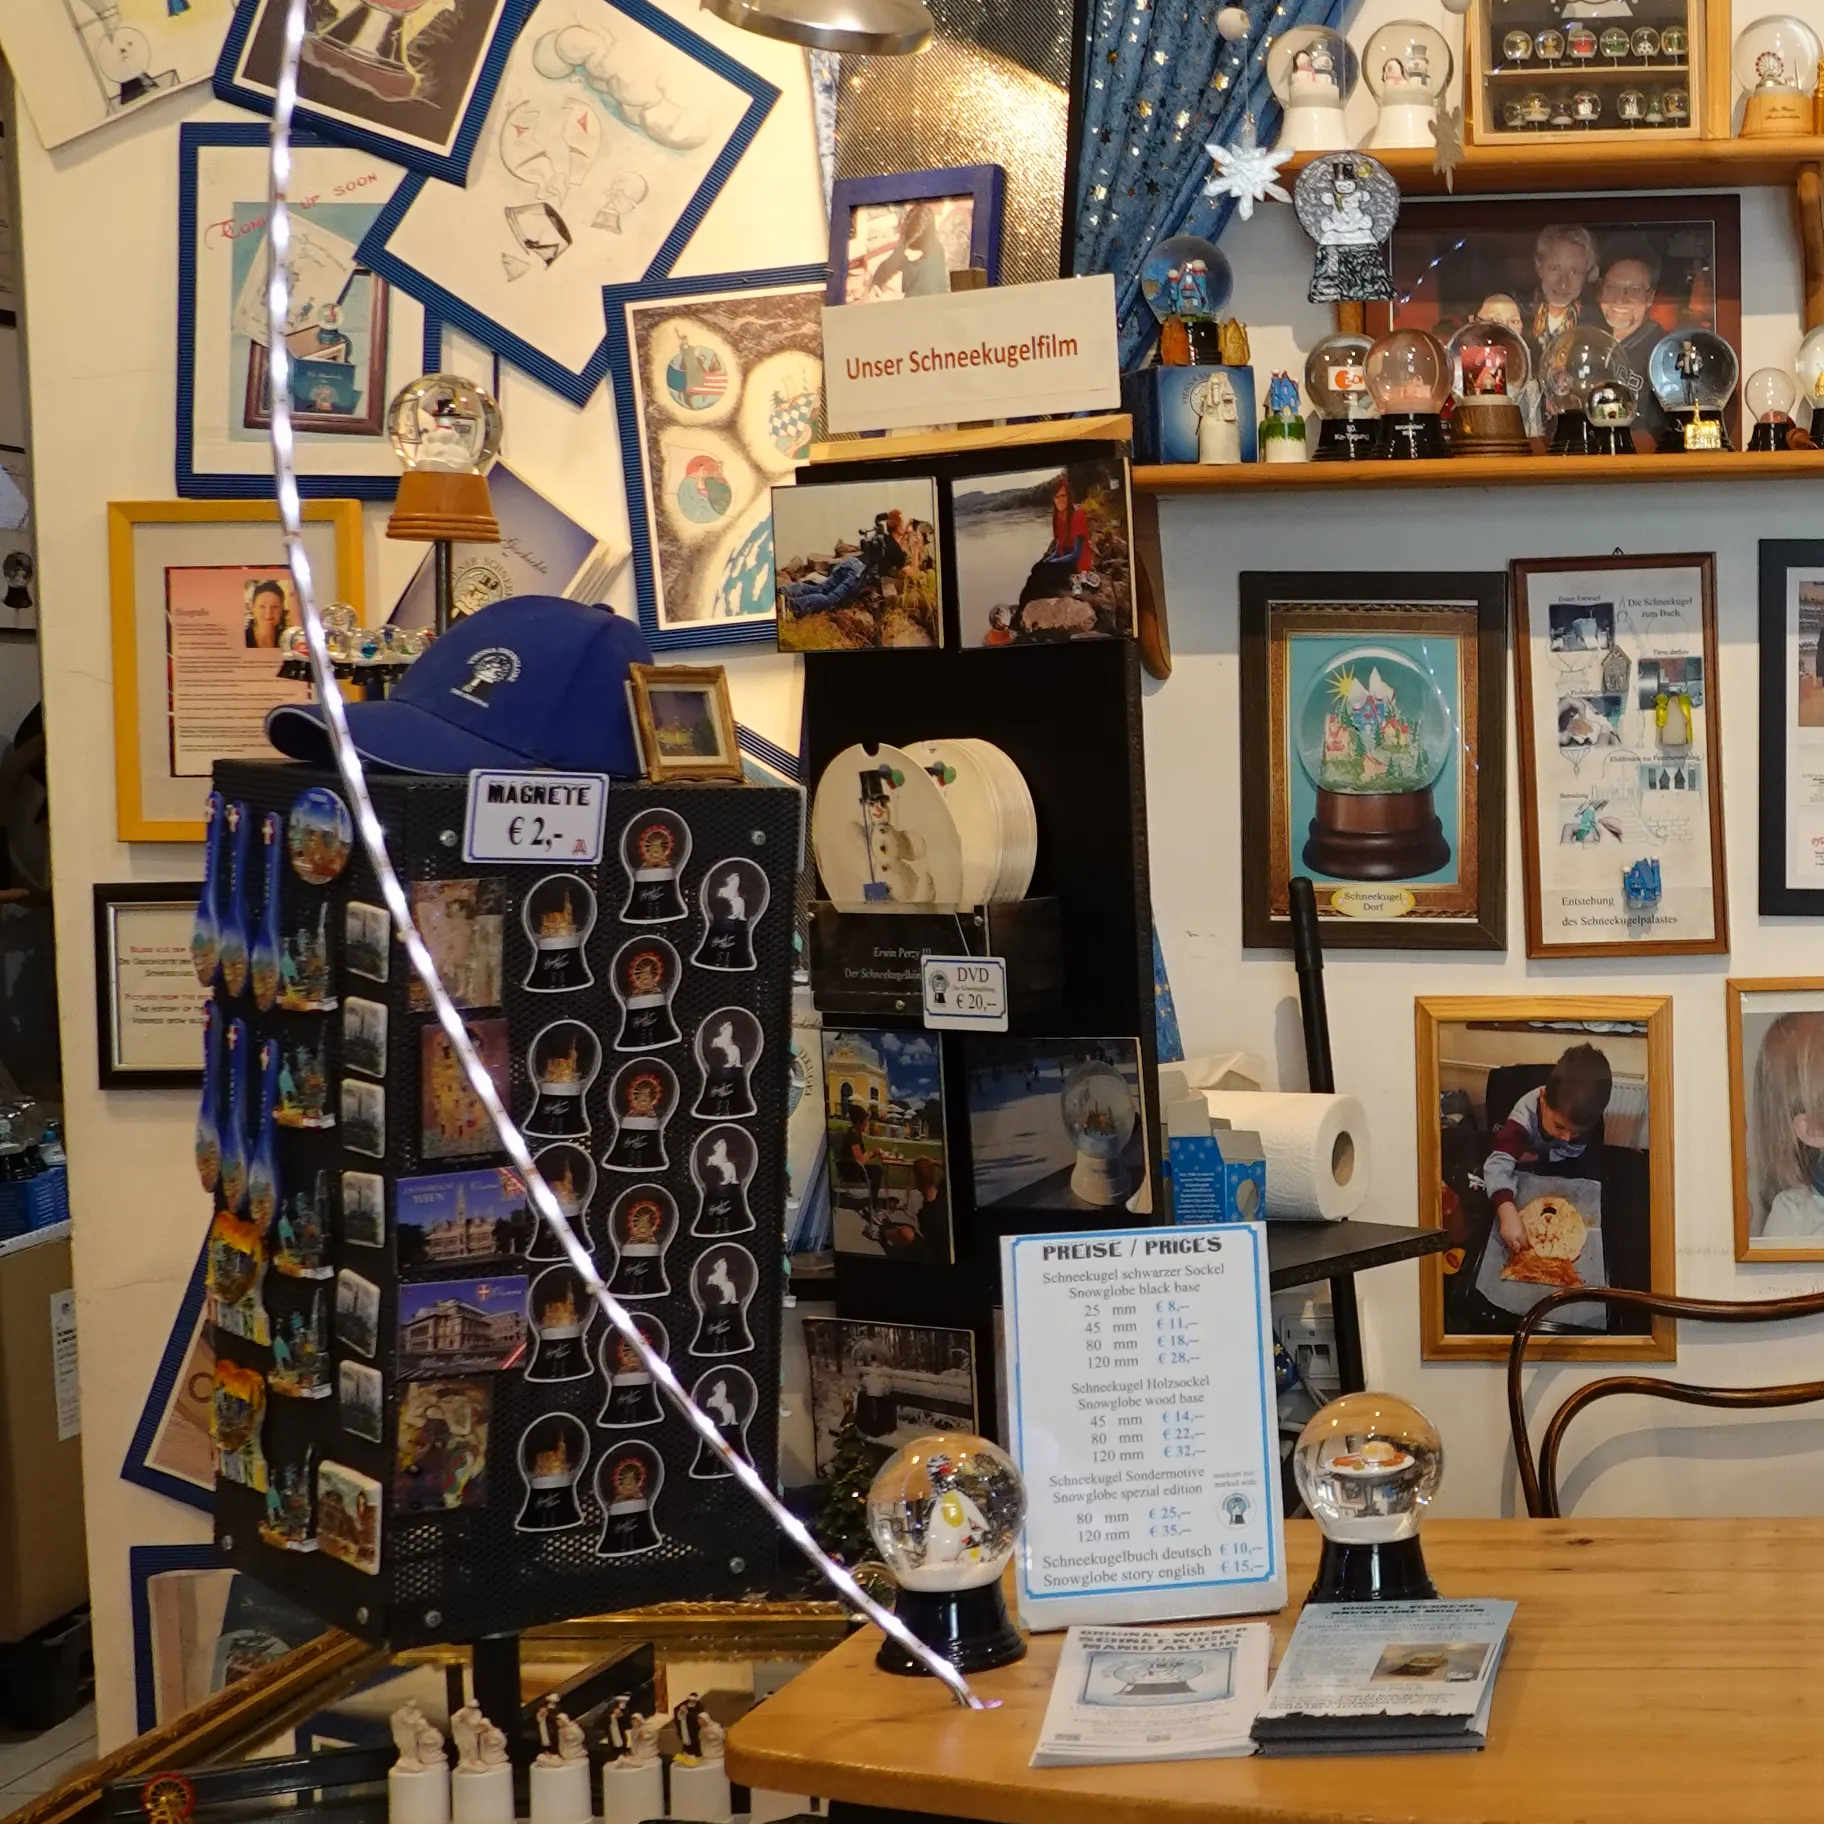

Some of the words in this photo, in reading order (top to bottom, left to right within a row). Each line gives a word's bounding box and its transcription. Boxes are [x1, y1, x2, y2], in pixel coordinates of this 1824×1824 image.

[333, 172, 378, 197] SOON
[846, 356, 904, 380] Unser
[909, 334, 1079, 373] Schneekugelfilm
[1628, 598, 1642, 608] Die
[1644, 597, 1693, 607] Schneekugel
[488, 780, 592, 806] MAGNETE
[508, 816, 525, 846] €
[1344, 891, 1403, 902] Schneekugel
[1561, 896, 1615, 907] Entstehung
[1363, 902, 1384, 912] Dorf
[1561, 916, 1578, 926] des
[1580, 914, 1678, 927] Schneekugelpalastes
[873, 947, 897, 958] Erwin
[844, 967, 859, 979] Der
[957, 967, 990, 983] DVD
[956, 993, 965, 1009] €
[1042, 1240, 1124, 1262] PREISE
[1129, 1237, 1138, 1257] /
[1144, 1236, 1223, 1256] PRICES
[1042, 1269, 1119, 1286] Schneekugel
[1122, 1266, 1182, 1281] schwarzer
[1184, 1263, 1225, 1277] Sockel
[1068, 1284, 1137, 1301] Snowglobe
[1138, 1281, 1176, 1296] black
[1178, 1281, 1201, 1294] base
[1084, 1304, 1101, 1318] 25
[1112, 1305, 1137, 1316] mm
[1156, 1301, 1165, 1314] €
[1084, 1321, 1101, 1335] 45
[1112, 1322, 1138, 1333] mm
[1157, 1318, 1166, 1331] €
[1085, 1339, 1102, 1352] 80
[1113, 1339, 1138, 1351] mm
[1157, 1335, 1167, 1348] €
[1087, 1355, 1110, 1370] 120
[1114, 1356, 1139, 1368] mm
[1158, 1352, 1167, 1365] €
[1071, 1380, 1144, 1396] Schneekugel
[1146, 1374, 1210, 1392] Holzsockel
[1078, 1396, 1142, 1412] Snowglobe
[1144, 1393, 1177, 1407] wood
[1179, 1392, 1205, 1405] base
[1090, 1415, 1106, 1429] 45
[1118, 1415, 1143, 1427] mm
[1161, 1411, 1171, 1424] €
[1090, 1432, 1107, 1446] 80
[1119, 1432, 1144, 1444] mm
[1162, 1428, 1171, 1441] €
[1092, 1449, 1116, 1463] 120
[1119, 1450, 1144, 1461] mm
[1163, 1445, 1172, 1458] €
[1049, 1472, 1124, 1489] Schneekugel
[1125, 1466, 1205, 1483] Sondermotive
[1052, 1489, 1119, 1505] Snowglobe
[1121, 1486, 1161, 1501] spezial
[1163, 1482, 1203, 1497] edition
[1076, 1512, 1093, 1526] 80
[1104, 1511, 1130, 1523] mm
[1148, 1507, 1157, 1521] €
[1077, 1528, 1101, 1543] 120
[1104, 1528, 1131, 1540] mm
[1149, 1525, 1158, 1538] €
[1042, 1550, 1159, 1569] Schneekugelbuch
[1162, 1544, 1212, 1561] deutsch
[1219, 1543, 1229, 1556] €
[1043, 1570, 1118, 1587] Snowglobe
[1121, 1568, 1155, 1583] story
[1158, 1562, 1206, 1579] english
[1221, 1561, 1230, 1574] €
